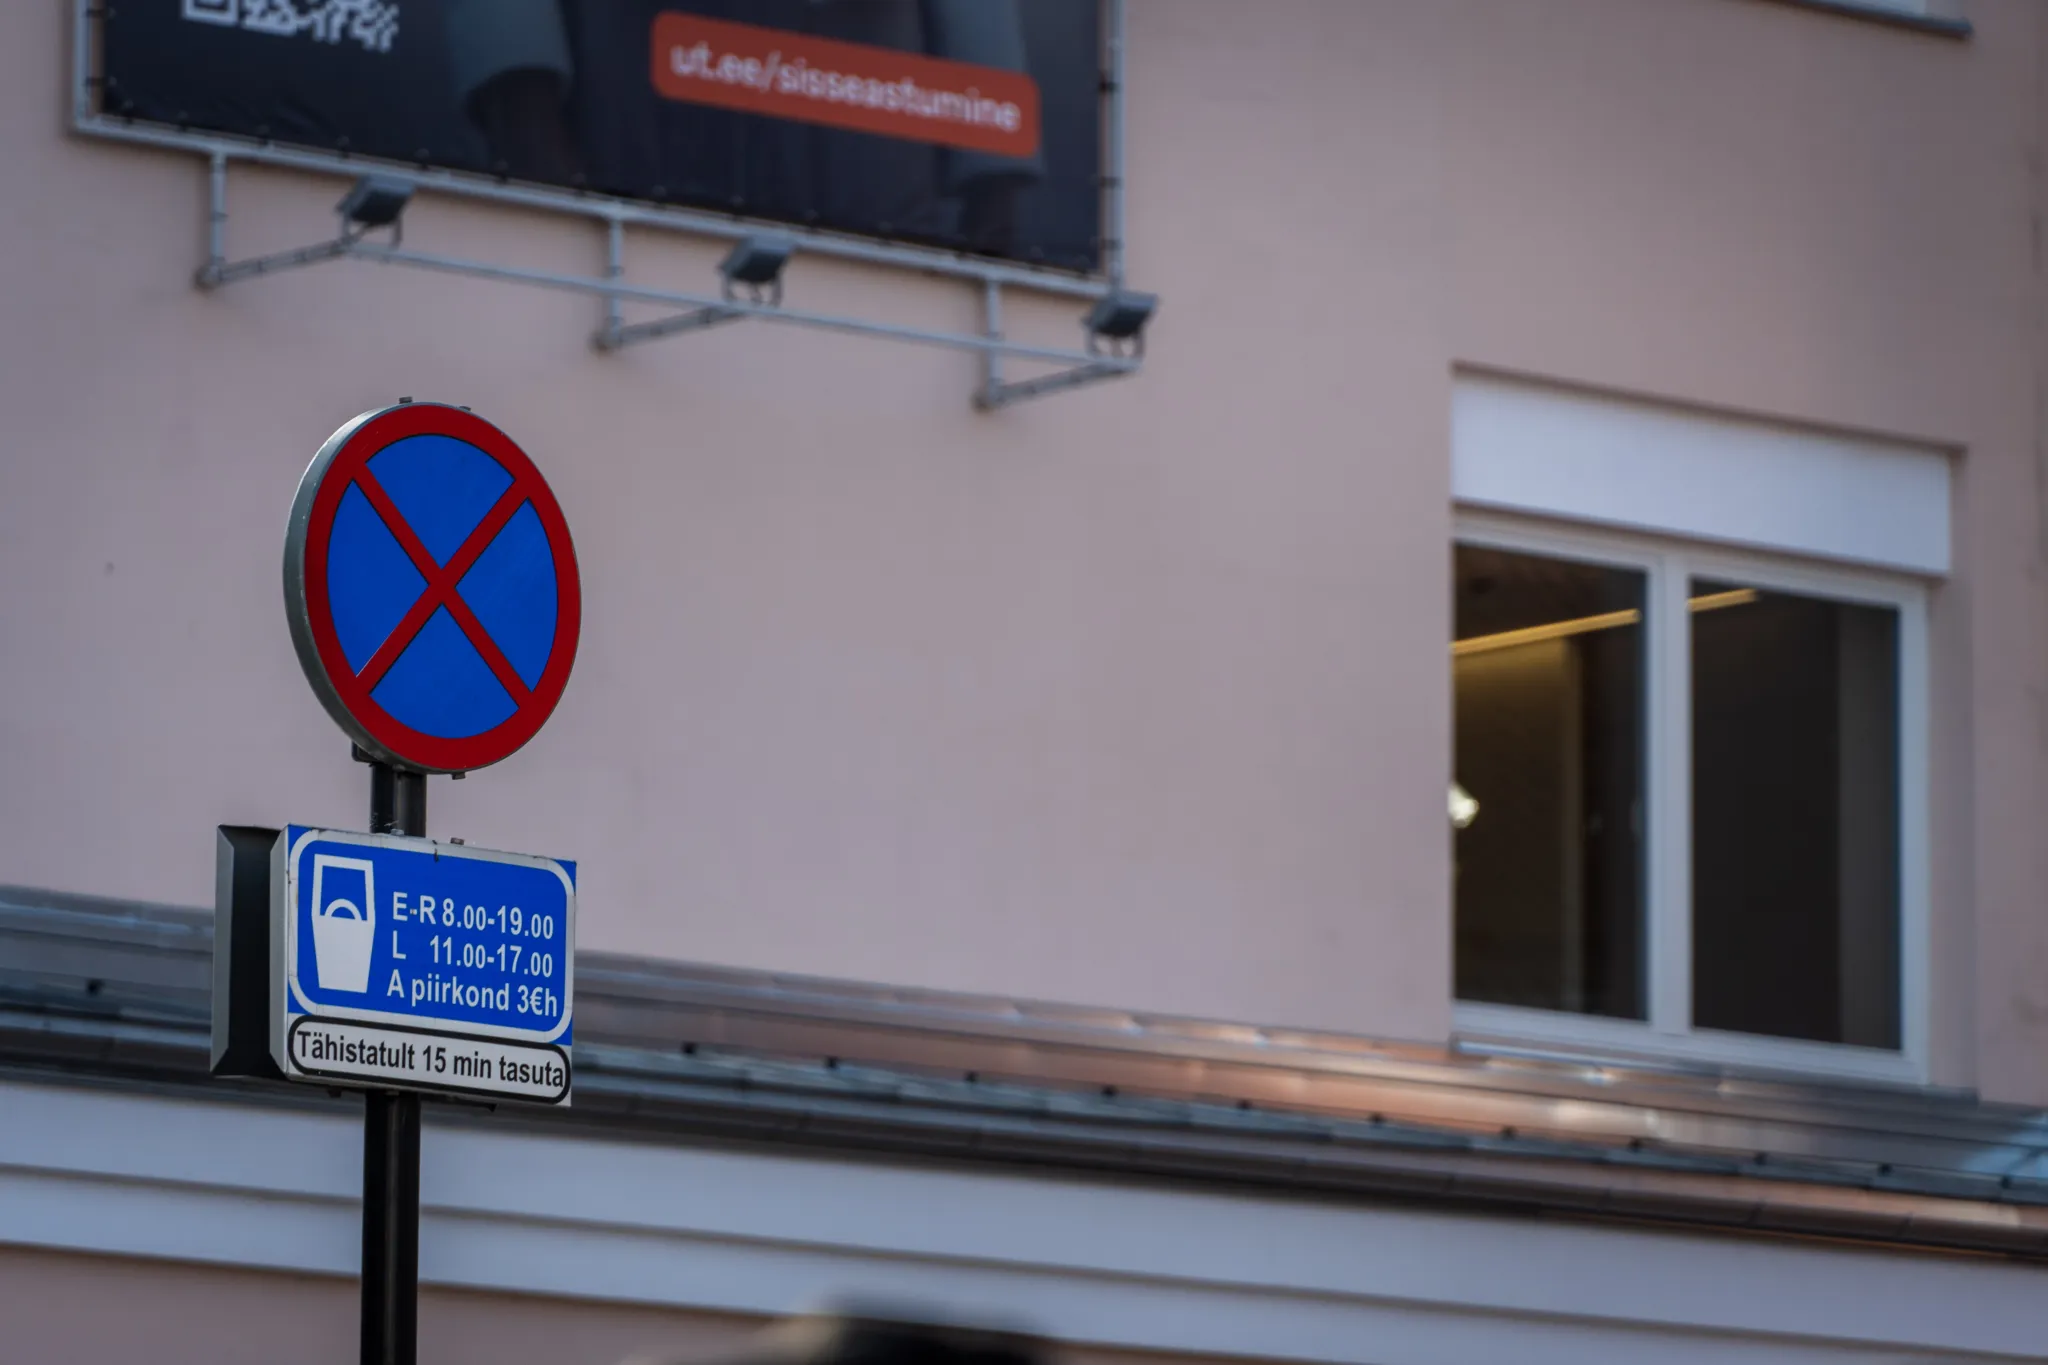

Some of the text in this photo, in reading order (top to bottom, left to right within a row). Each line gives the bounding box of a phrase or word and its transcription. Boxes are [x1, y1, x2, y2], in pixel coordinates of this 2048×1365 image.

[669, 41, 1022, 133] ut.ee/sisseastumine
[392, 891, 554, 940] E-R 8.00-19.00
[392, 930, 553, 978] L 11.00-17.00
[386, 969, 557, 1017] A piirkond 3€h
[297, 1031, 564, 1088] Tähistatult 15 min tasuta
